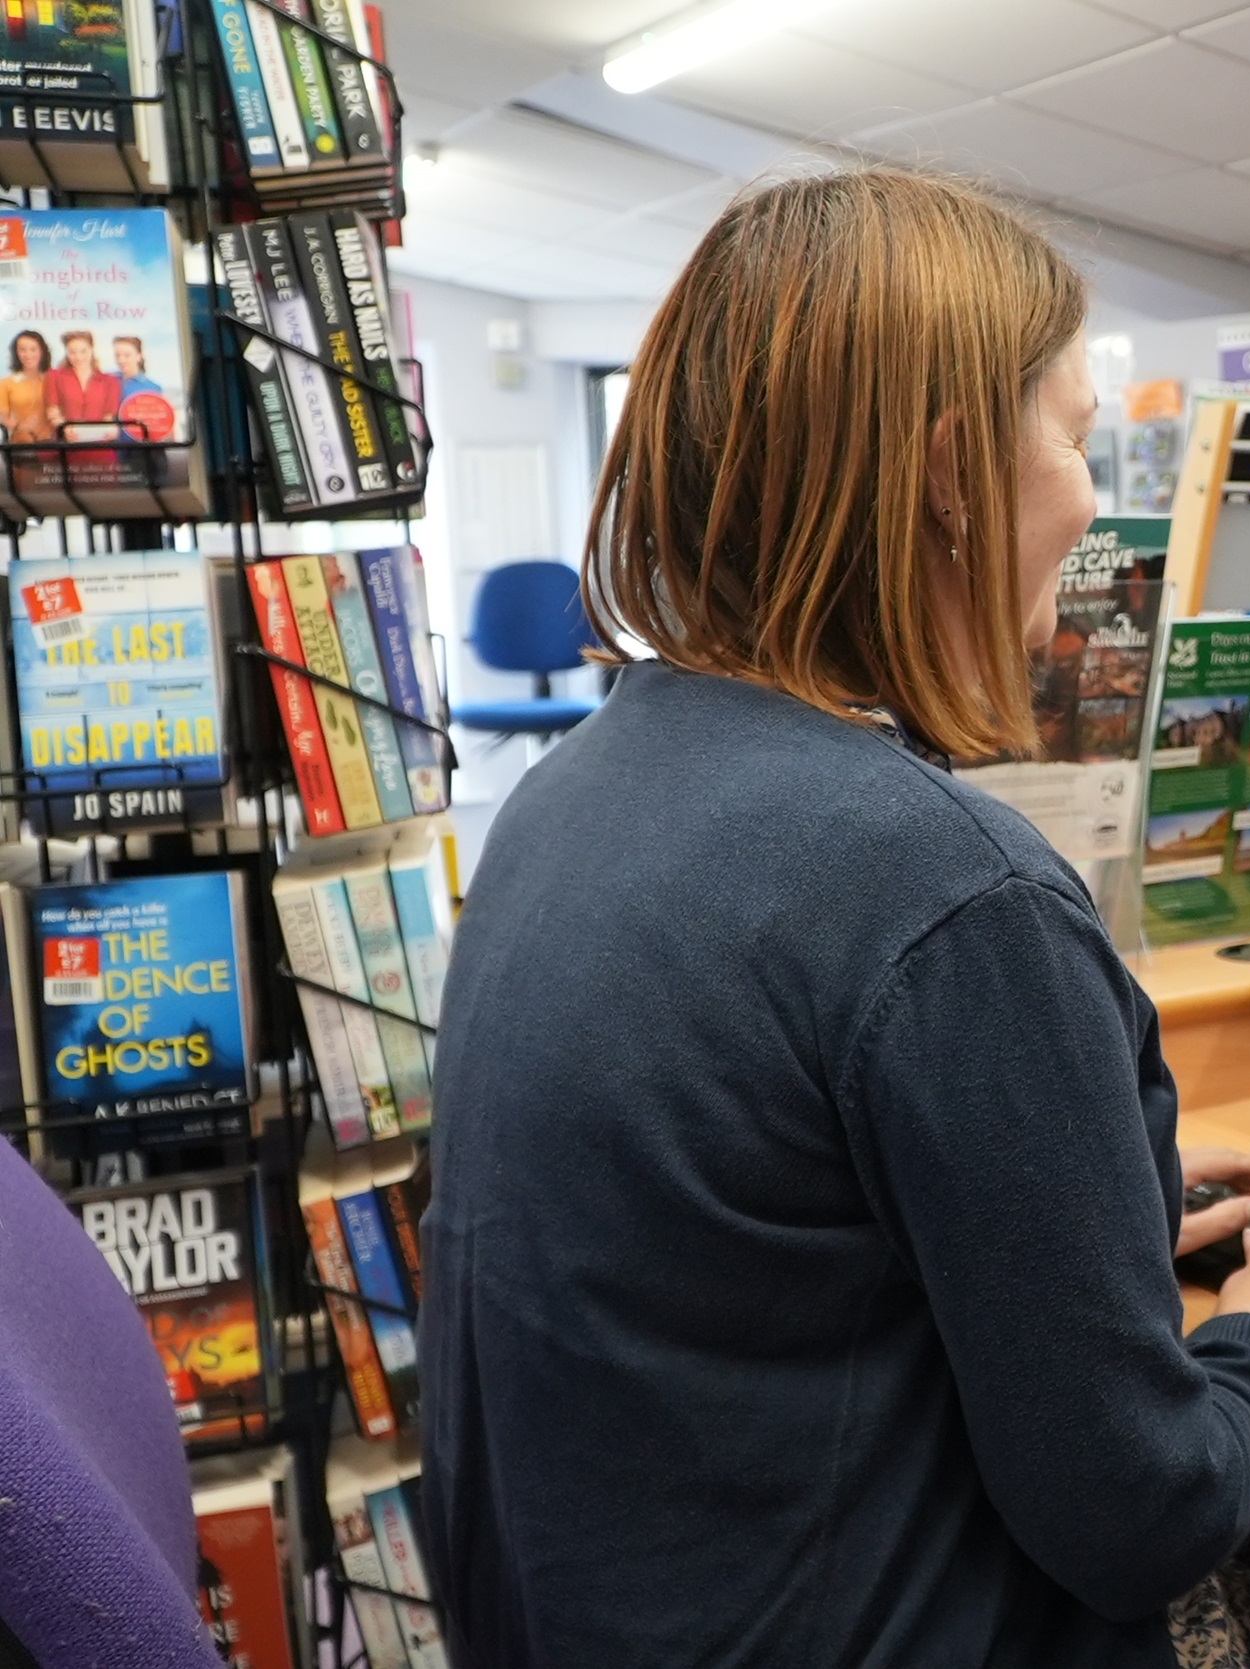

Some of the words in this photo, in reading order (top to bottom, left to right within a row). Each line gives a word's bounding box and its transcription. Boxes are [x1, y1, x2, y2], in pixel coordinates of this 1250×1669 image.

[222, 12, 252, 74] GONE
[290, 26, 314, 84] GARDEN
[306, 85, 326, 128] PARTY
[336, 64, 366, 118] PARK
[262, 228, 283, 258] MJ
[335, 227, 369, 279] HARD
[33, 263, 130, 290] ongbirds
[271, 262, 294, 302] LEE
[311, 252, 339, 325] CORRIGAN
[347, 280, 374, 306] AS
[96, 301, 147, 320] Row
[353, 306, 388, 361] NAILS
[305, 391, 328, 440] GUILTY
[329, 331, 352, 363] THE
[346, 403, 377, 458] SISTER
[278, 452, 300, 486] NIGHT
[1056, 568, 1116, 594] TURE
[1083, 547, 1136, 572] CAVE
[112, 621, 186, 665] LAST
[297, 606, 325, 679] ATTAC
[312, 611, 341, 675] UNDER
[107, 680, 132, 706] TO
[31, 716, 216, 768] DISAPPEAR
[73, 792, 100, 821] JO
[109, 789, 183, 818] SPAIN
[101, 929, 172, 965] THE
[98, 1003, 152, 1039] OF
[55, 1031, 213, 1080] GHOSTS
[83, 1188, 216, 1252] BRAD
[102, 1231, 241, 1297] AYLOR
